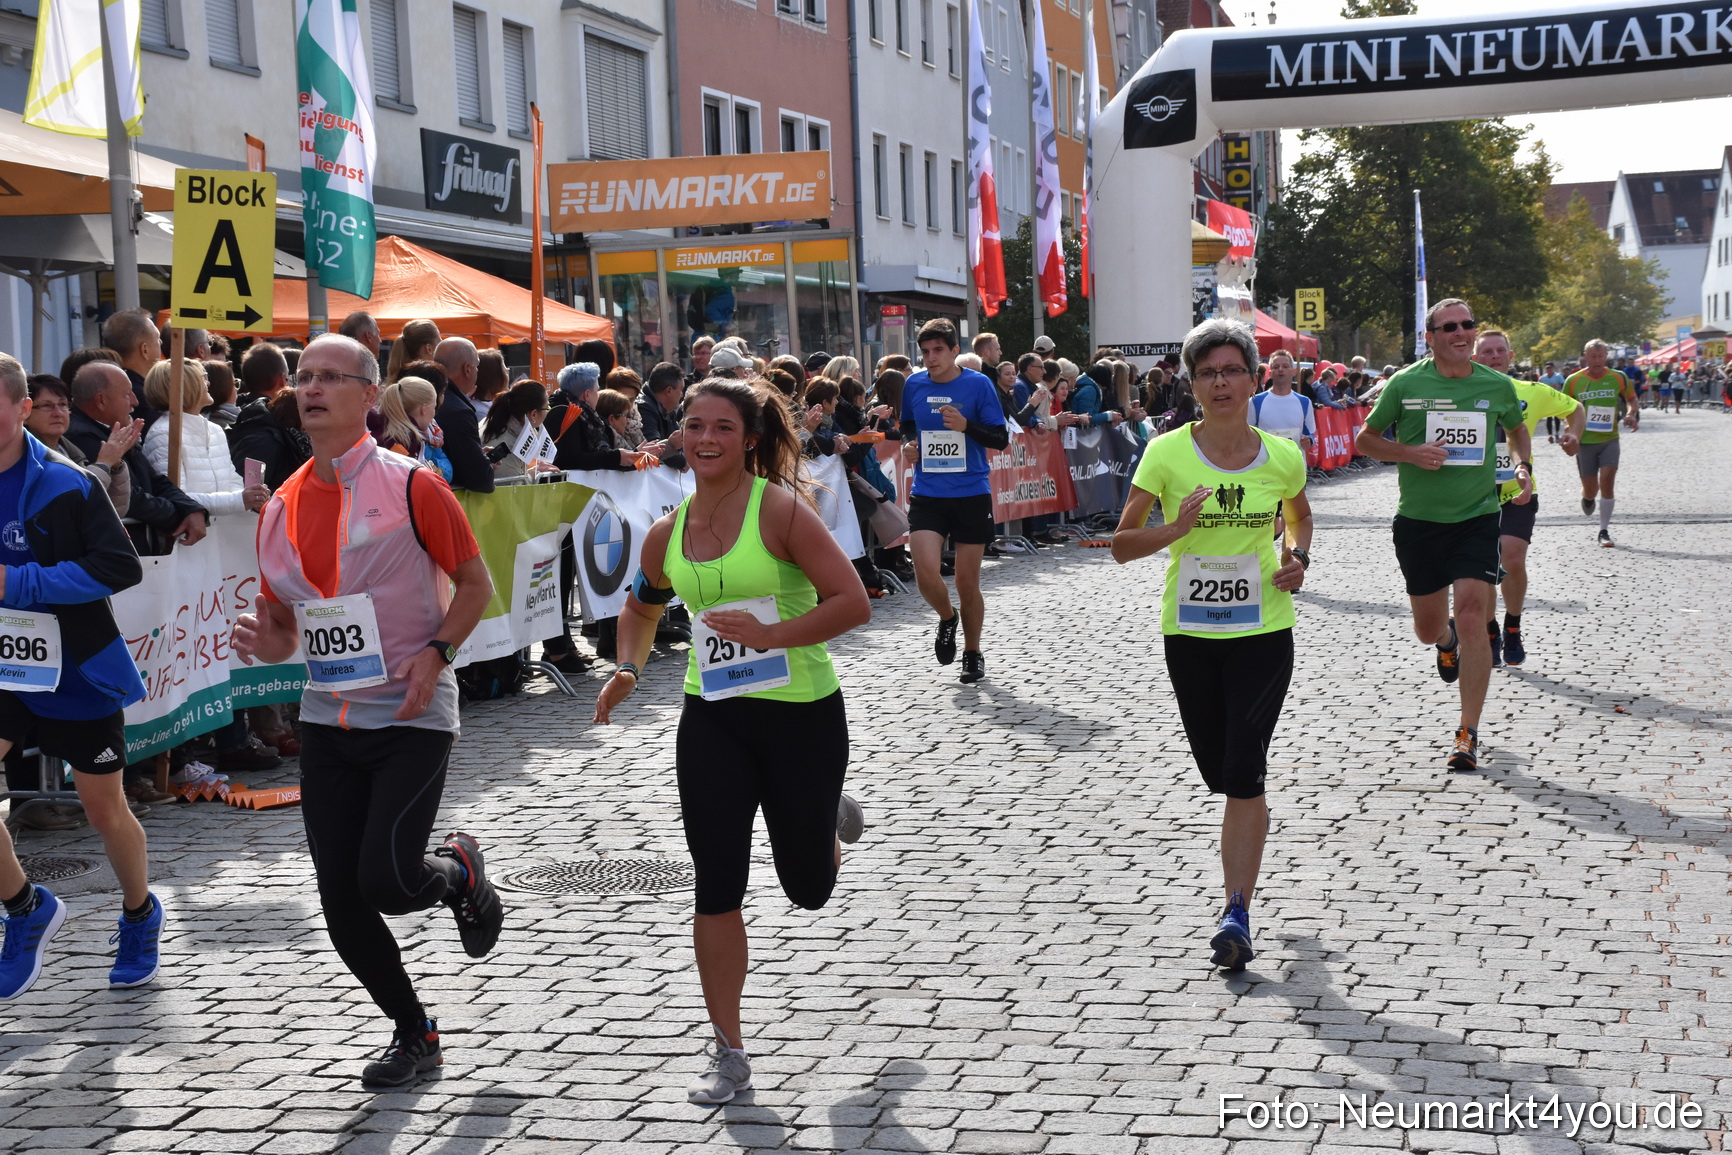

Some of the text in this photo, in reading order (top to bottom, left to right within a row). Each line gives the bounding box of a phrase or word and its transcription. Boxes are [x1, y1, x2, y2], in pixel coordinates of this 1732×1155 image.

[1265, 8, 1732, 88] MINI NEUMARK
[1150, 104, 1169, 113] MINI
[434, 142, 519, 212] frühauf
[188, 175, 266, 208] Block
[559, 171, 817, 215] RUNMARKT.DE
[193, 219, 252, 297] A
[676, 249, 775, 267] RUNMARKT.DE
[1298, 290, 1321, 299] Block
[1302, 301, 1317, 321] B
[1578, 389, 1616, 400] BOCK
[1591, 413, 1611, 423] 2748
[1435, 427, 1477, 445] 2555
[519, 434, 534, 457] swn
[540, 437, 552, 458] swn
[928, 443, 959, 456] 2502
[1208, 562, 1238, 570] BOCK
[1189, 578, 1250, 603] 2256
[313, 605, 346, 616] BOCK
[1206, 609, 1232, 620] Ingrid
[4, 617, 35, 626] BOCK
[0, 634, 48, 662] 696
[304, 624, 365, 656] 2093
[705, 636, 769, 664] 257
[0, 667, 26, 678] Kevin
[320, 665, 355, 676] Andreas
[727, 667, 755, 681] Maria
[93, 755, 118, 764] adidas
